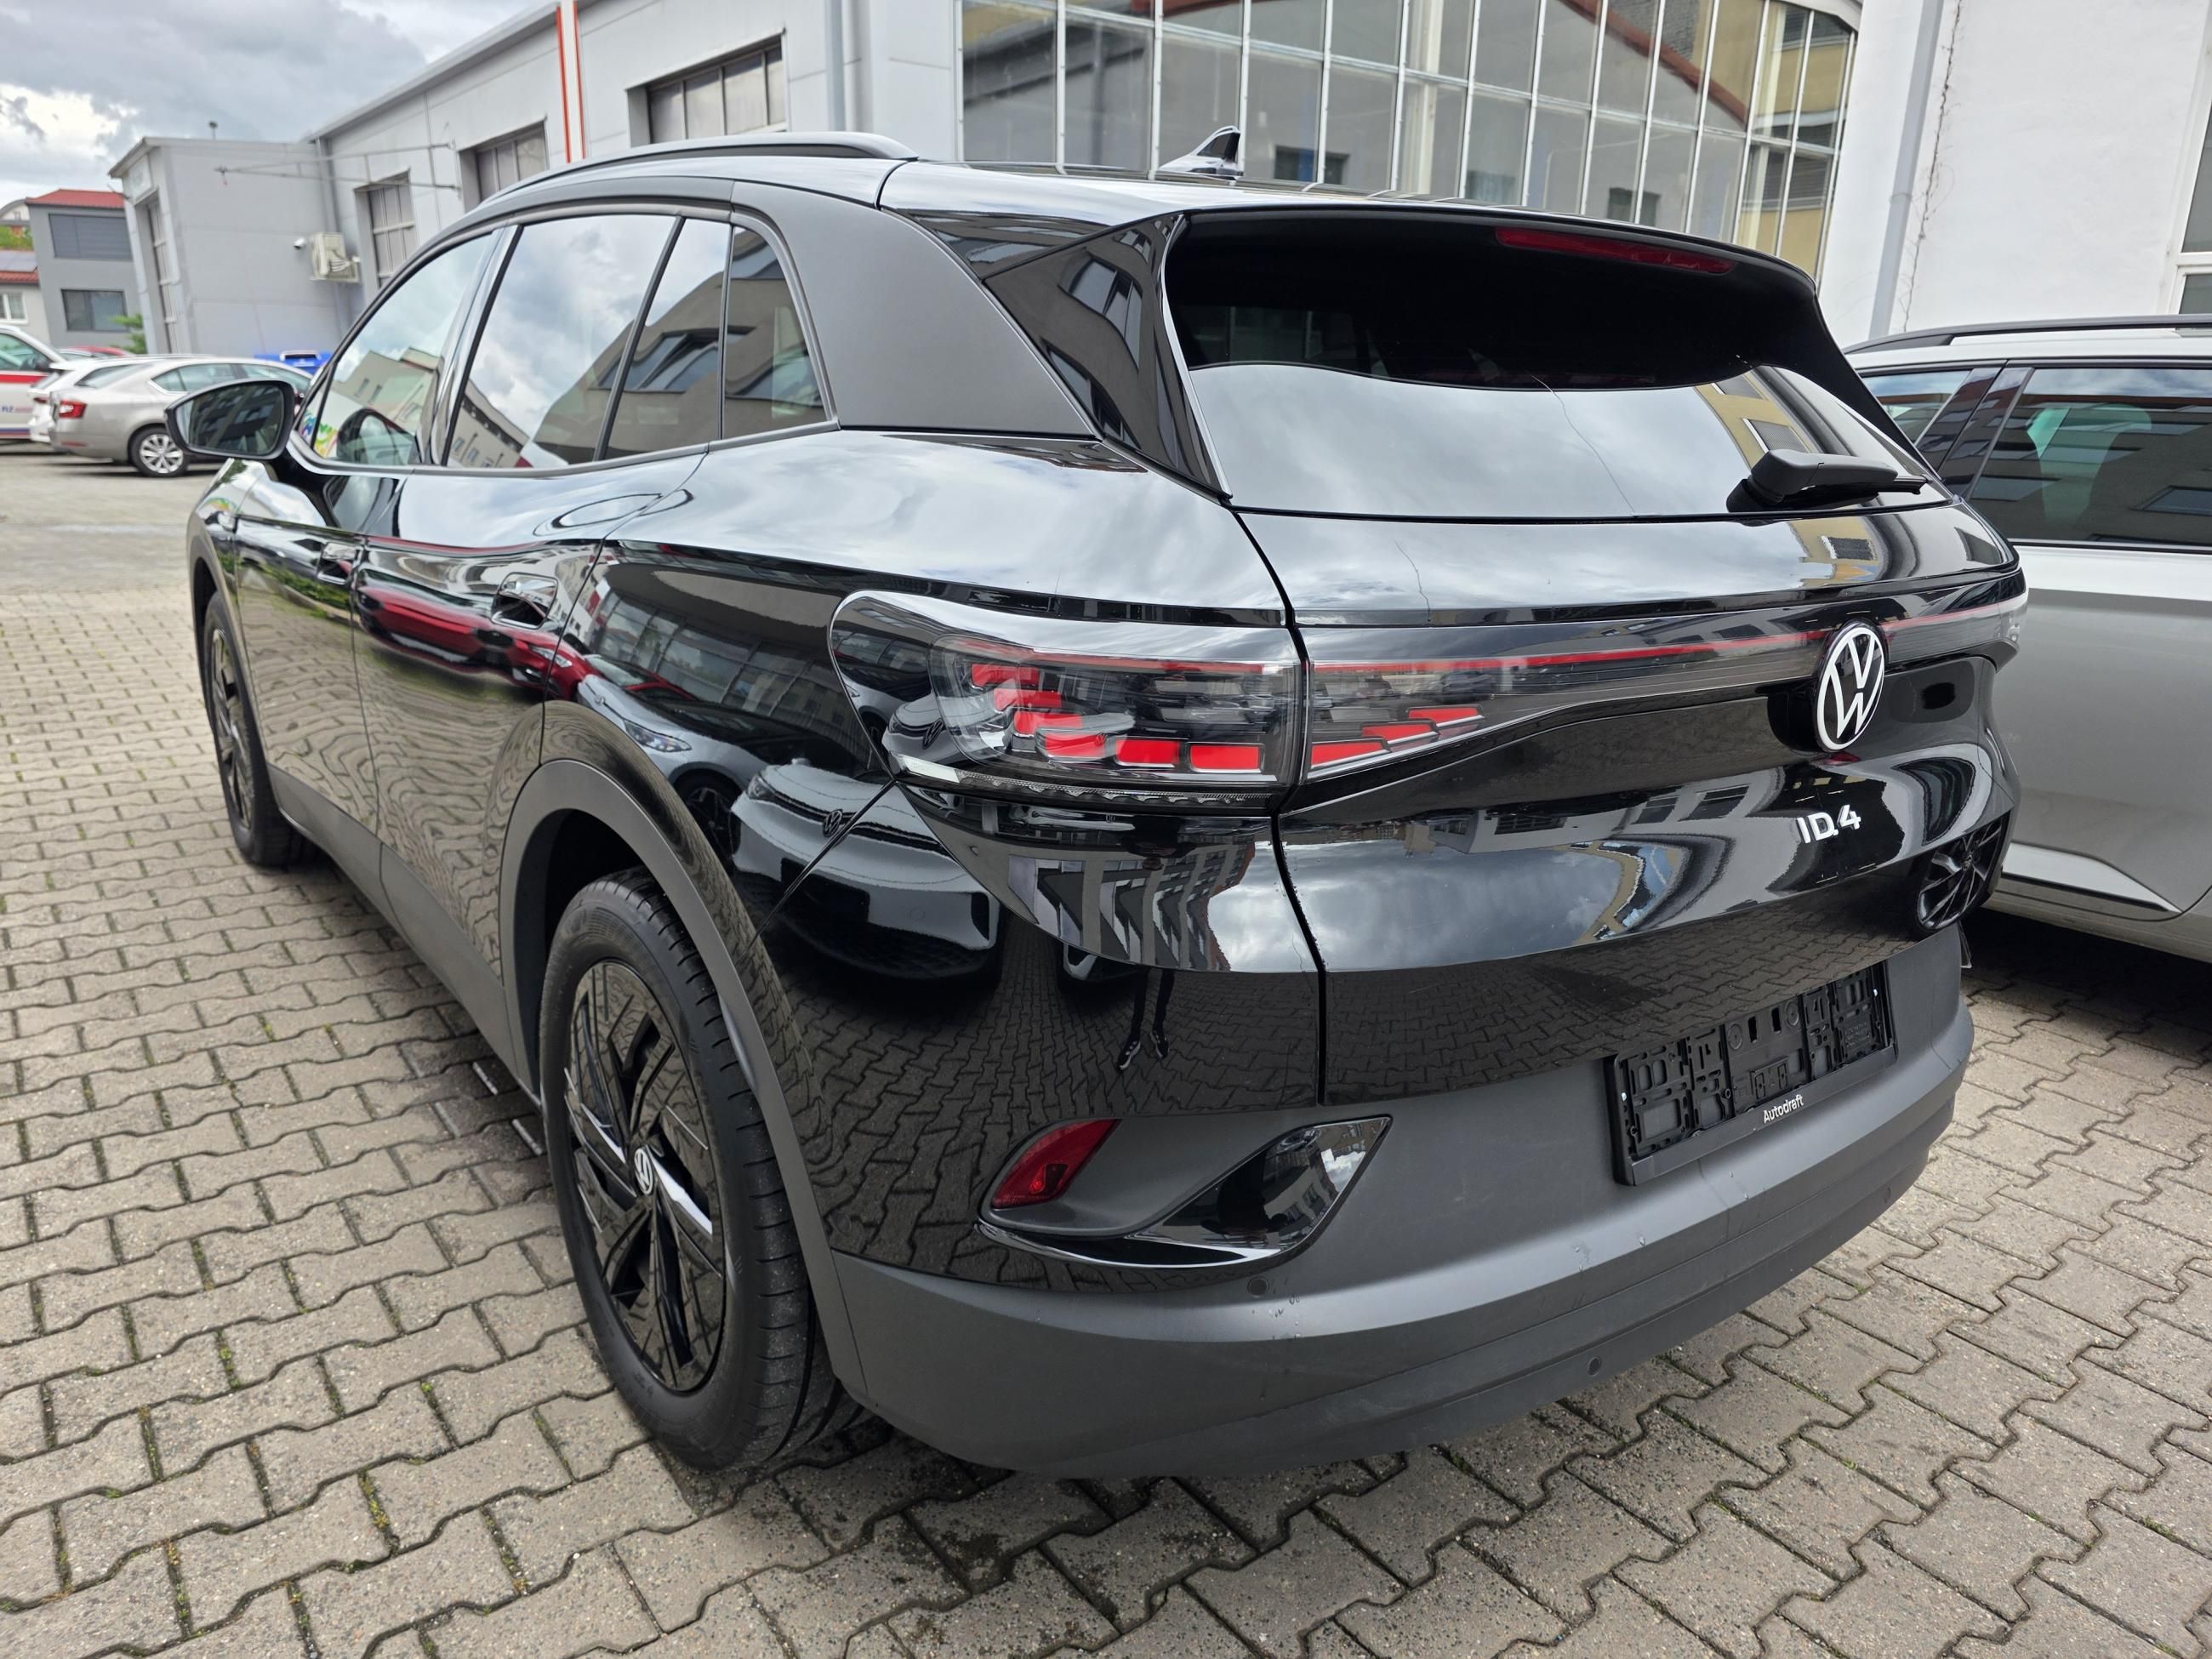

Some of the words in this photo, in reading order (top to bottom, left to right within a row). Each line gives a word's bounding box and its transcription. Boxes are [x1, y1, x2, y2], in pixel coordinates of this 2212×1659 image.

[1818, 627, 1884, 750] VW
[1763, 1094, 1804, 1124] Autodraft
[634, 1149, 653, 1194] VW
